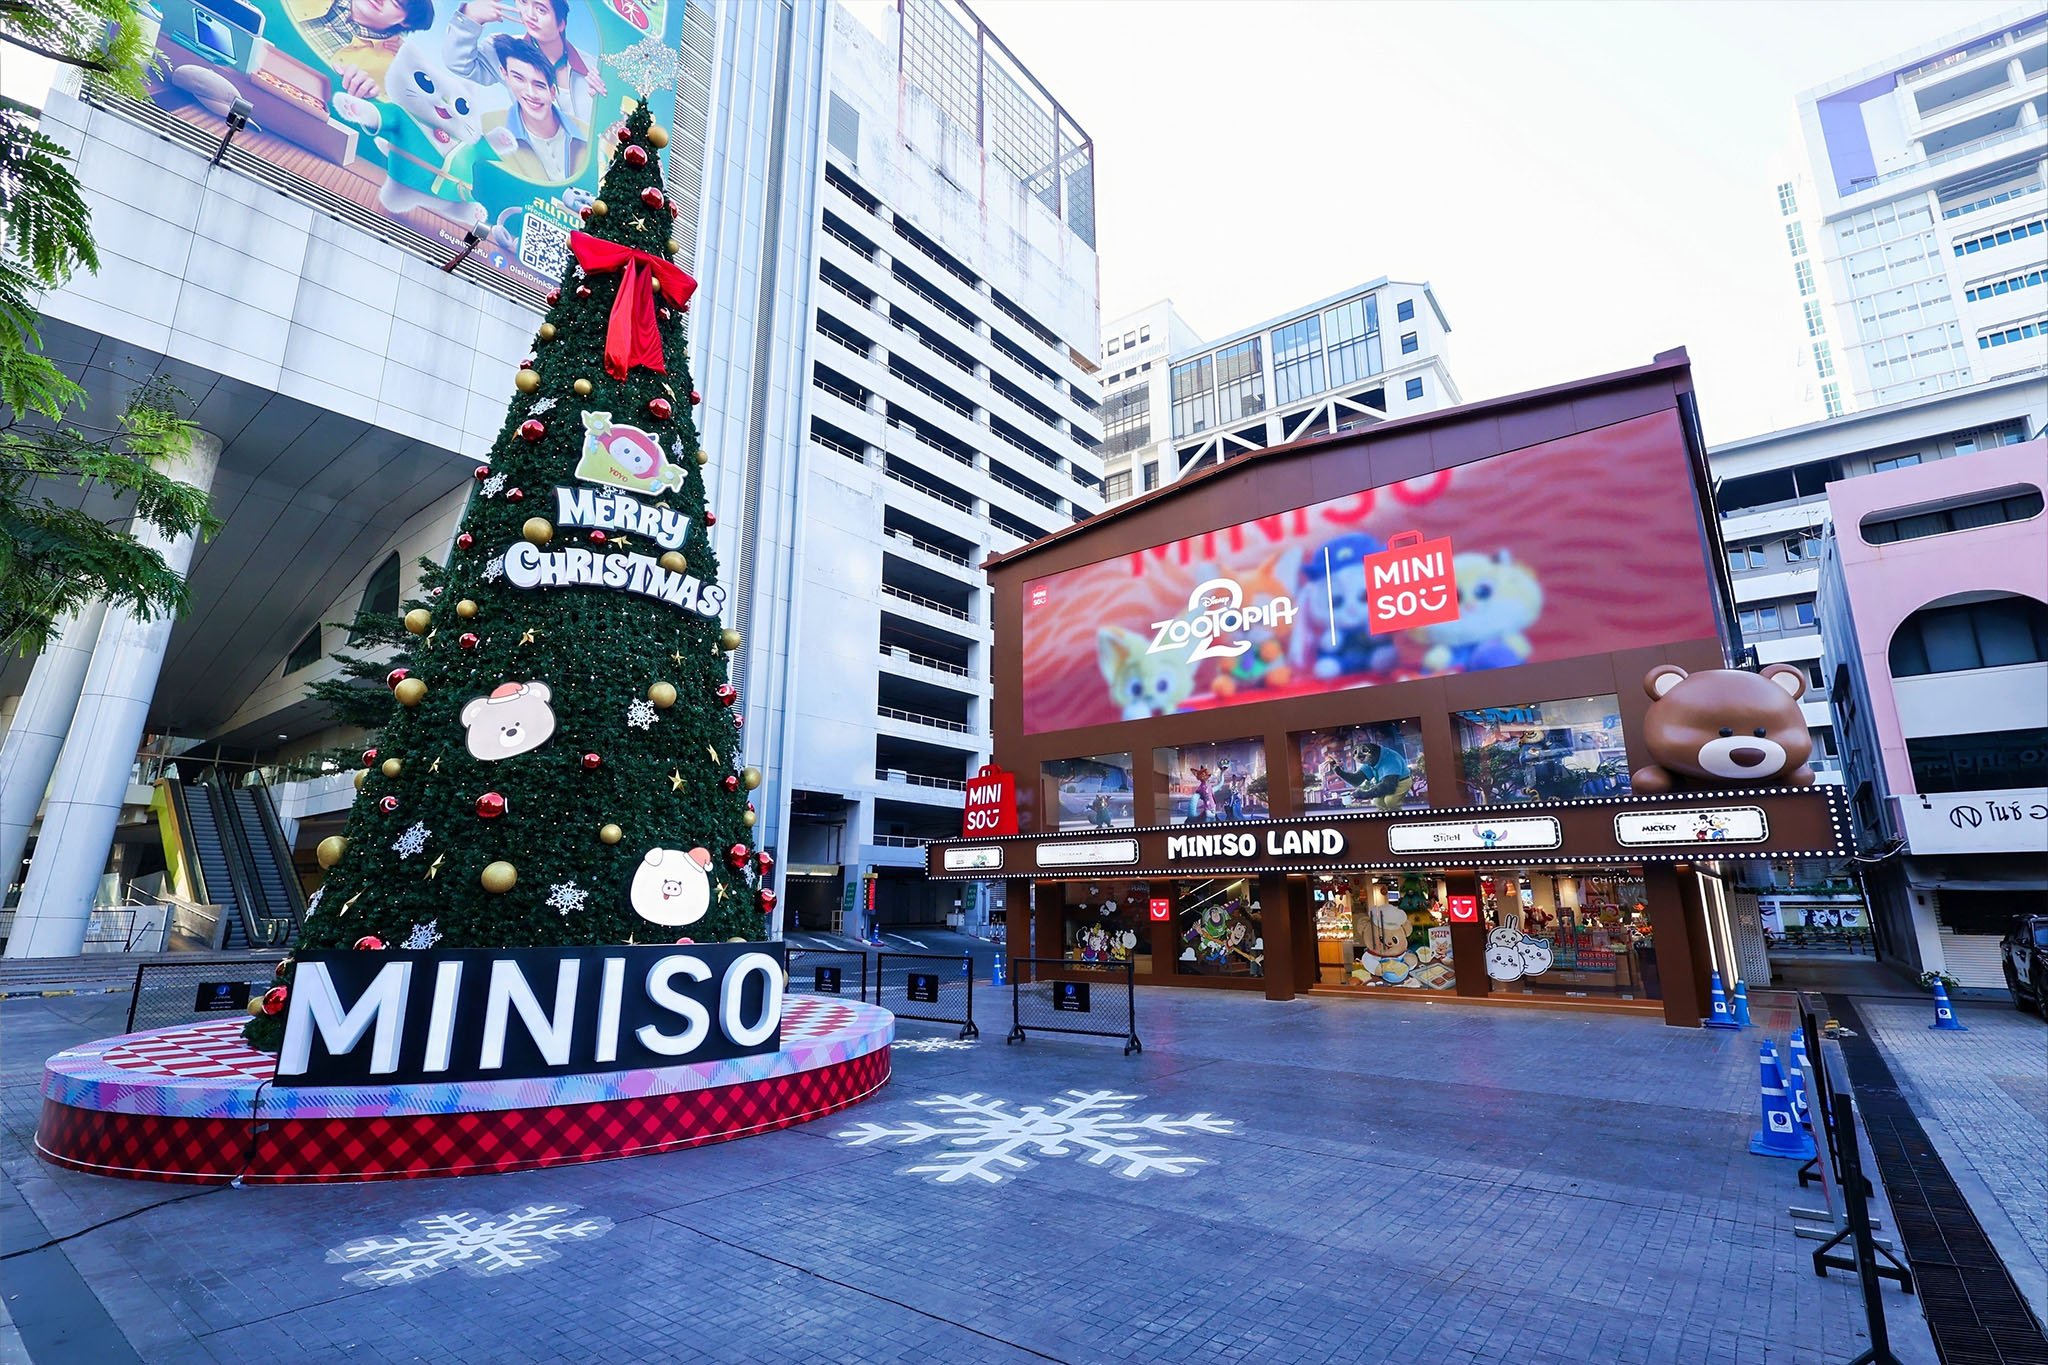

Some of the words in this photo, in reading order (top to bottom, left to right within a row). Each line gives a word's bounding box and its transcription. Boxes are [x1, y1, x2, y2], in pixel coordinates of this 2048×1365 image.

[533, 196, 580, 230] สแกน
[556, 487, 690, 549] MERRY
[504, 541, 726, 617] CHRISTMAS
[1373, 551, 1445, 590] MINI
[1145, 596, 1299, 655] ZOOTOPIA
[968, 783, 1002, 807] MINI
[1167, 833, 1257, 860] MINISO
[1266, 828, 1344, 856] LAND
[1641, 824, 1677, 832] MICKEY
[278, 952, 784, 1076] MINISO
